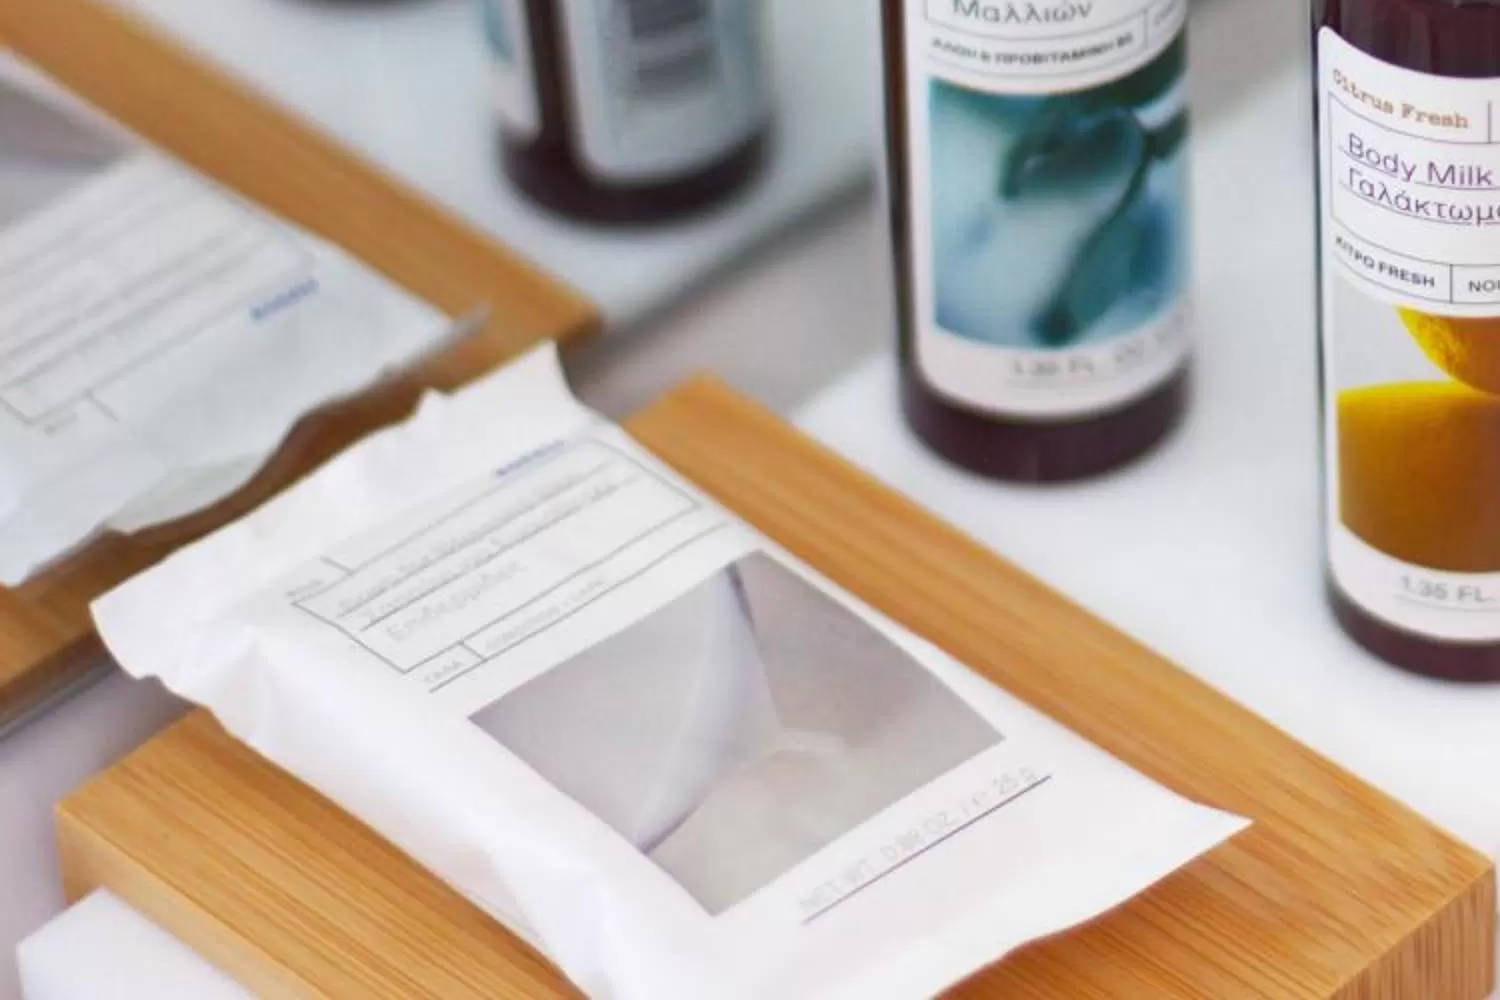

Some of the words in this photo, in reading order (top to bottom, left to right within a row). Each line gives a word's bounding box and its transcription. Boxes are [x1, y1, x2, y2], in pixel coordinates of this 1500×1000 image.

[1332, 68, 1394, 115] Citrus
[1400, 102, 1469, 130] Fresh
[1348, 132, 1416, 182] Body
[1428, 160, 1494, 187] Milk
[1378, 260, 1436, 289] FRESH
